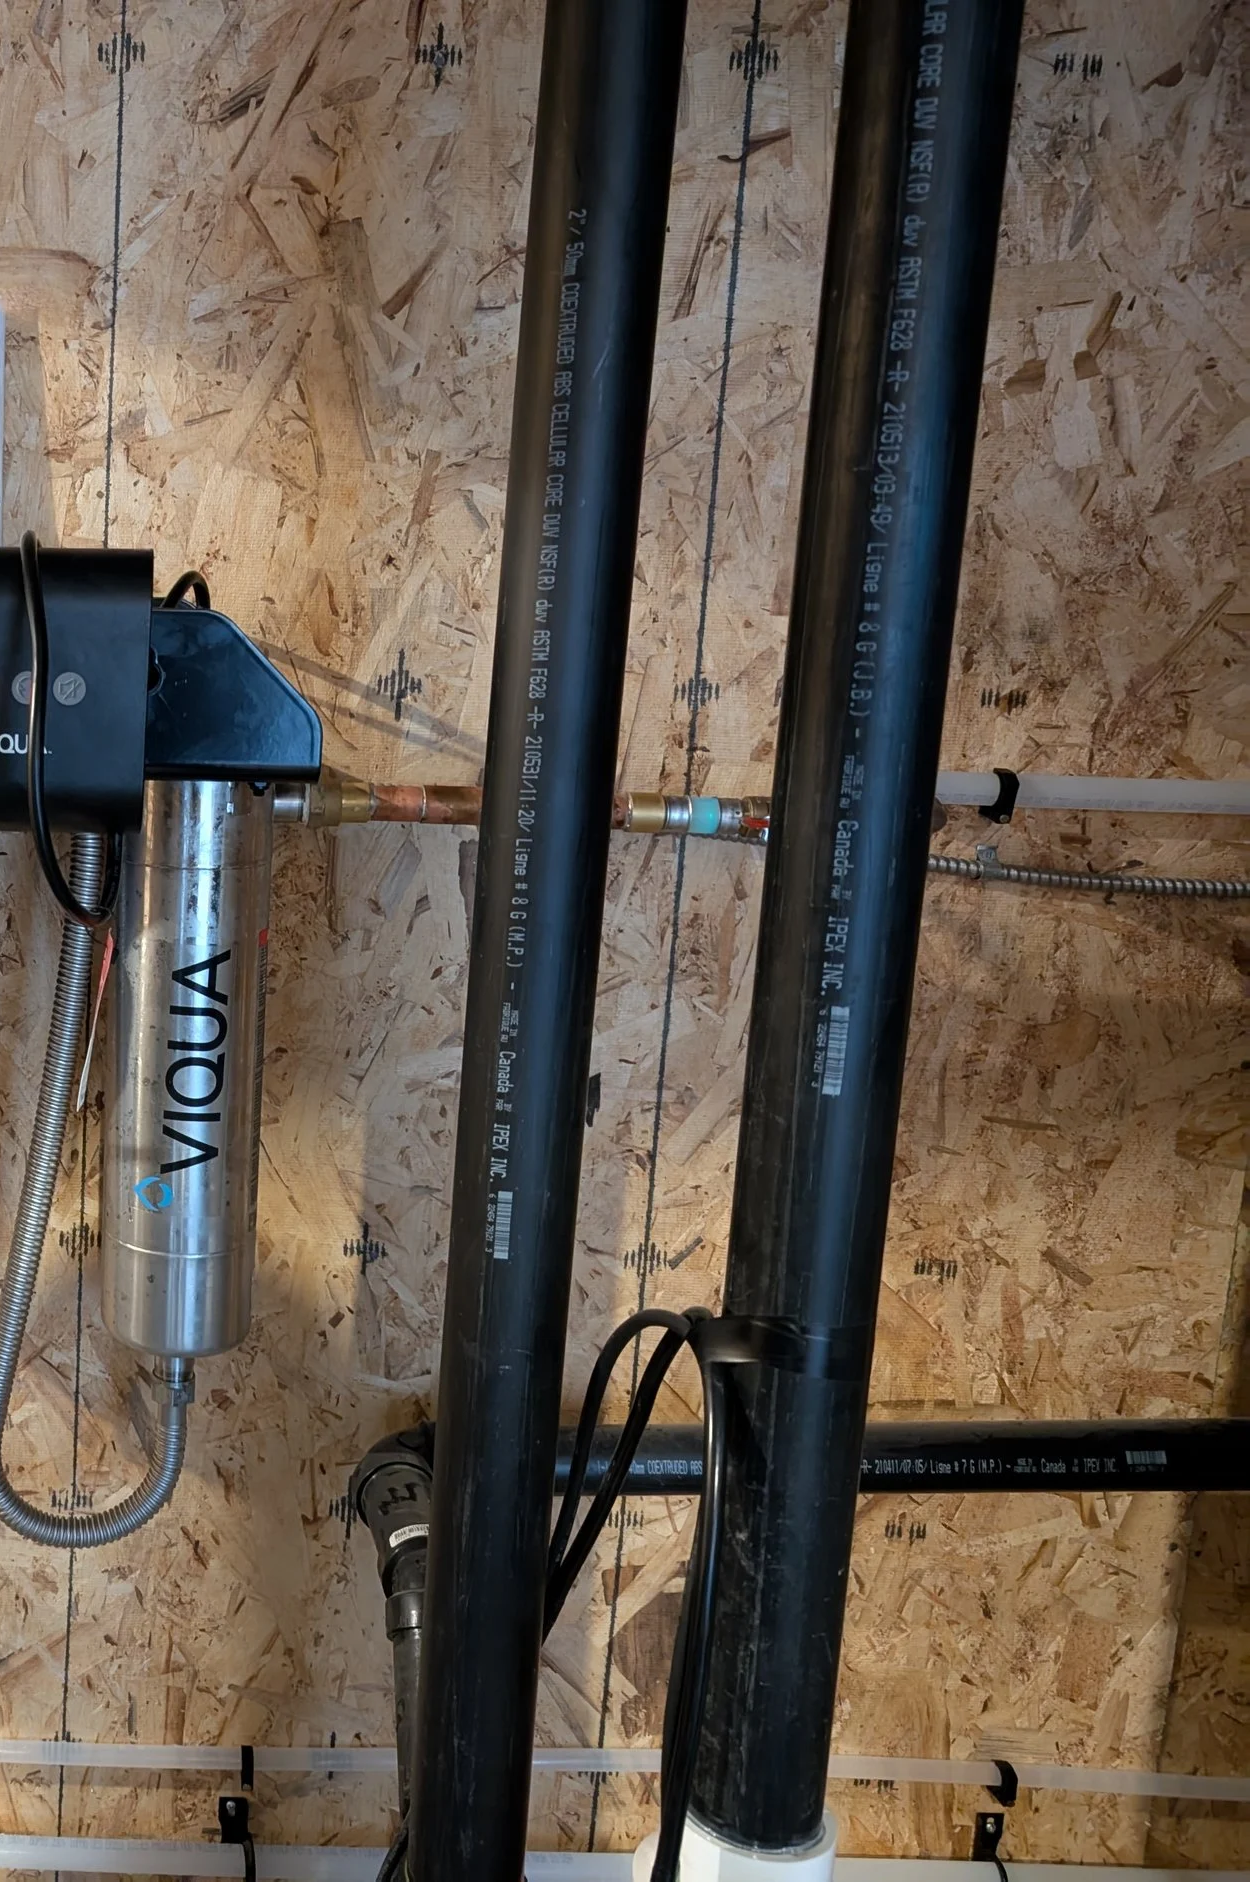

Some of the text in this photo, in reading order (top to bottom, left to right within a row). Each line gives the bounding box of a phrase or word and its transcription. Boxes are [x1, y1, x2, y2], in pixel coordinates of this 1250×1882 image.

[919, 42, 943, 91] CORE
[908, 138, 934, 203] NSF(R)
[898, 255, 922, 301] ASTM
[557, 281, 580, 365] COEXTRUDED
[892, 307, 916, 352] F628
[554, 369, 573, 397] ABS
[548, 402, 569, 468] CELLULAR
[545, 473, 563, 508] CORE
[538, 544, 557, 591] NSF(R)
[864, 541, 888, 594] Ligne
[535, 599, 552, 622] dwv
[858, 621, 878, 633] 8
[532, 629, 550, 662] ASTM
[856, 640, 876, 652] G
[529, 667, 547, 700] F628
[528, 705, 544, 730] -R-
[518, 734, 542, 832] 210531/11:20/
[514, 837, 532, 876] Ligne
[834, 818, 859, 877] Canada
[509, 911, 526, 919] G
[511, 897, 528, 905] 8
[507, 926, 525, 968] (M.P.)
[822, 915, 849, 997] IPEX INC.
[160, 949, 231, 1174] VIQUA
[497, 1050, 516, 1093] Canada
[490, 1123, 509, 1183] IPEX INC.
[647, 1460, 688, 1475] COEXTRUDED
[690, 1460, 703, 1475] ABS
[930, 1460, 952, 1474] Ligne
[961, 1459, 967, 1474] 7
[1041, 1458, 1066, 1473] Canada
[1084, 1458, 1100, 1473] IPEX
